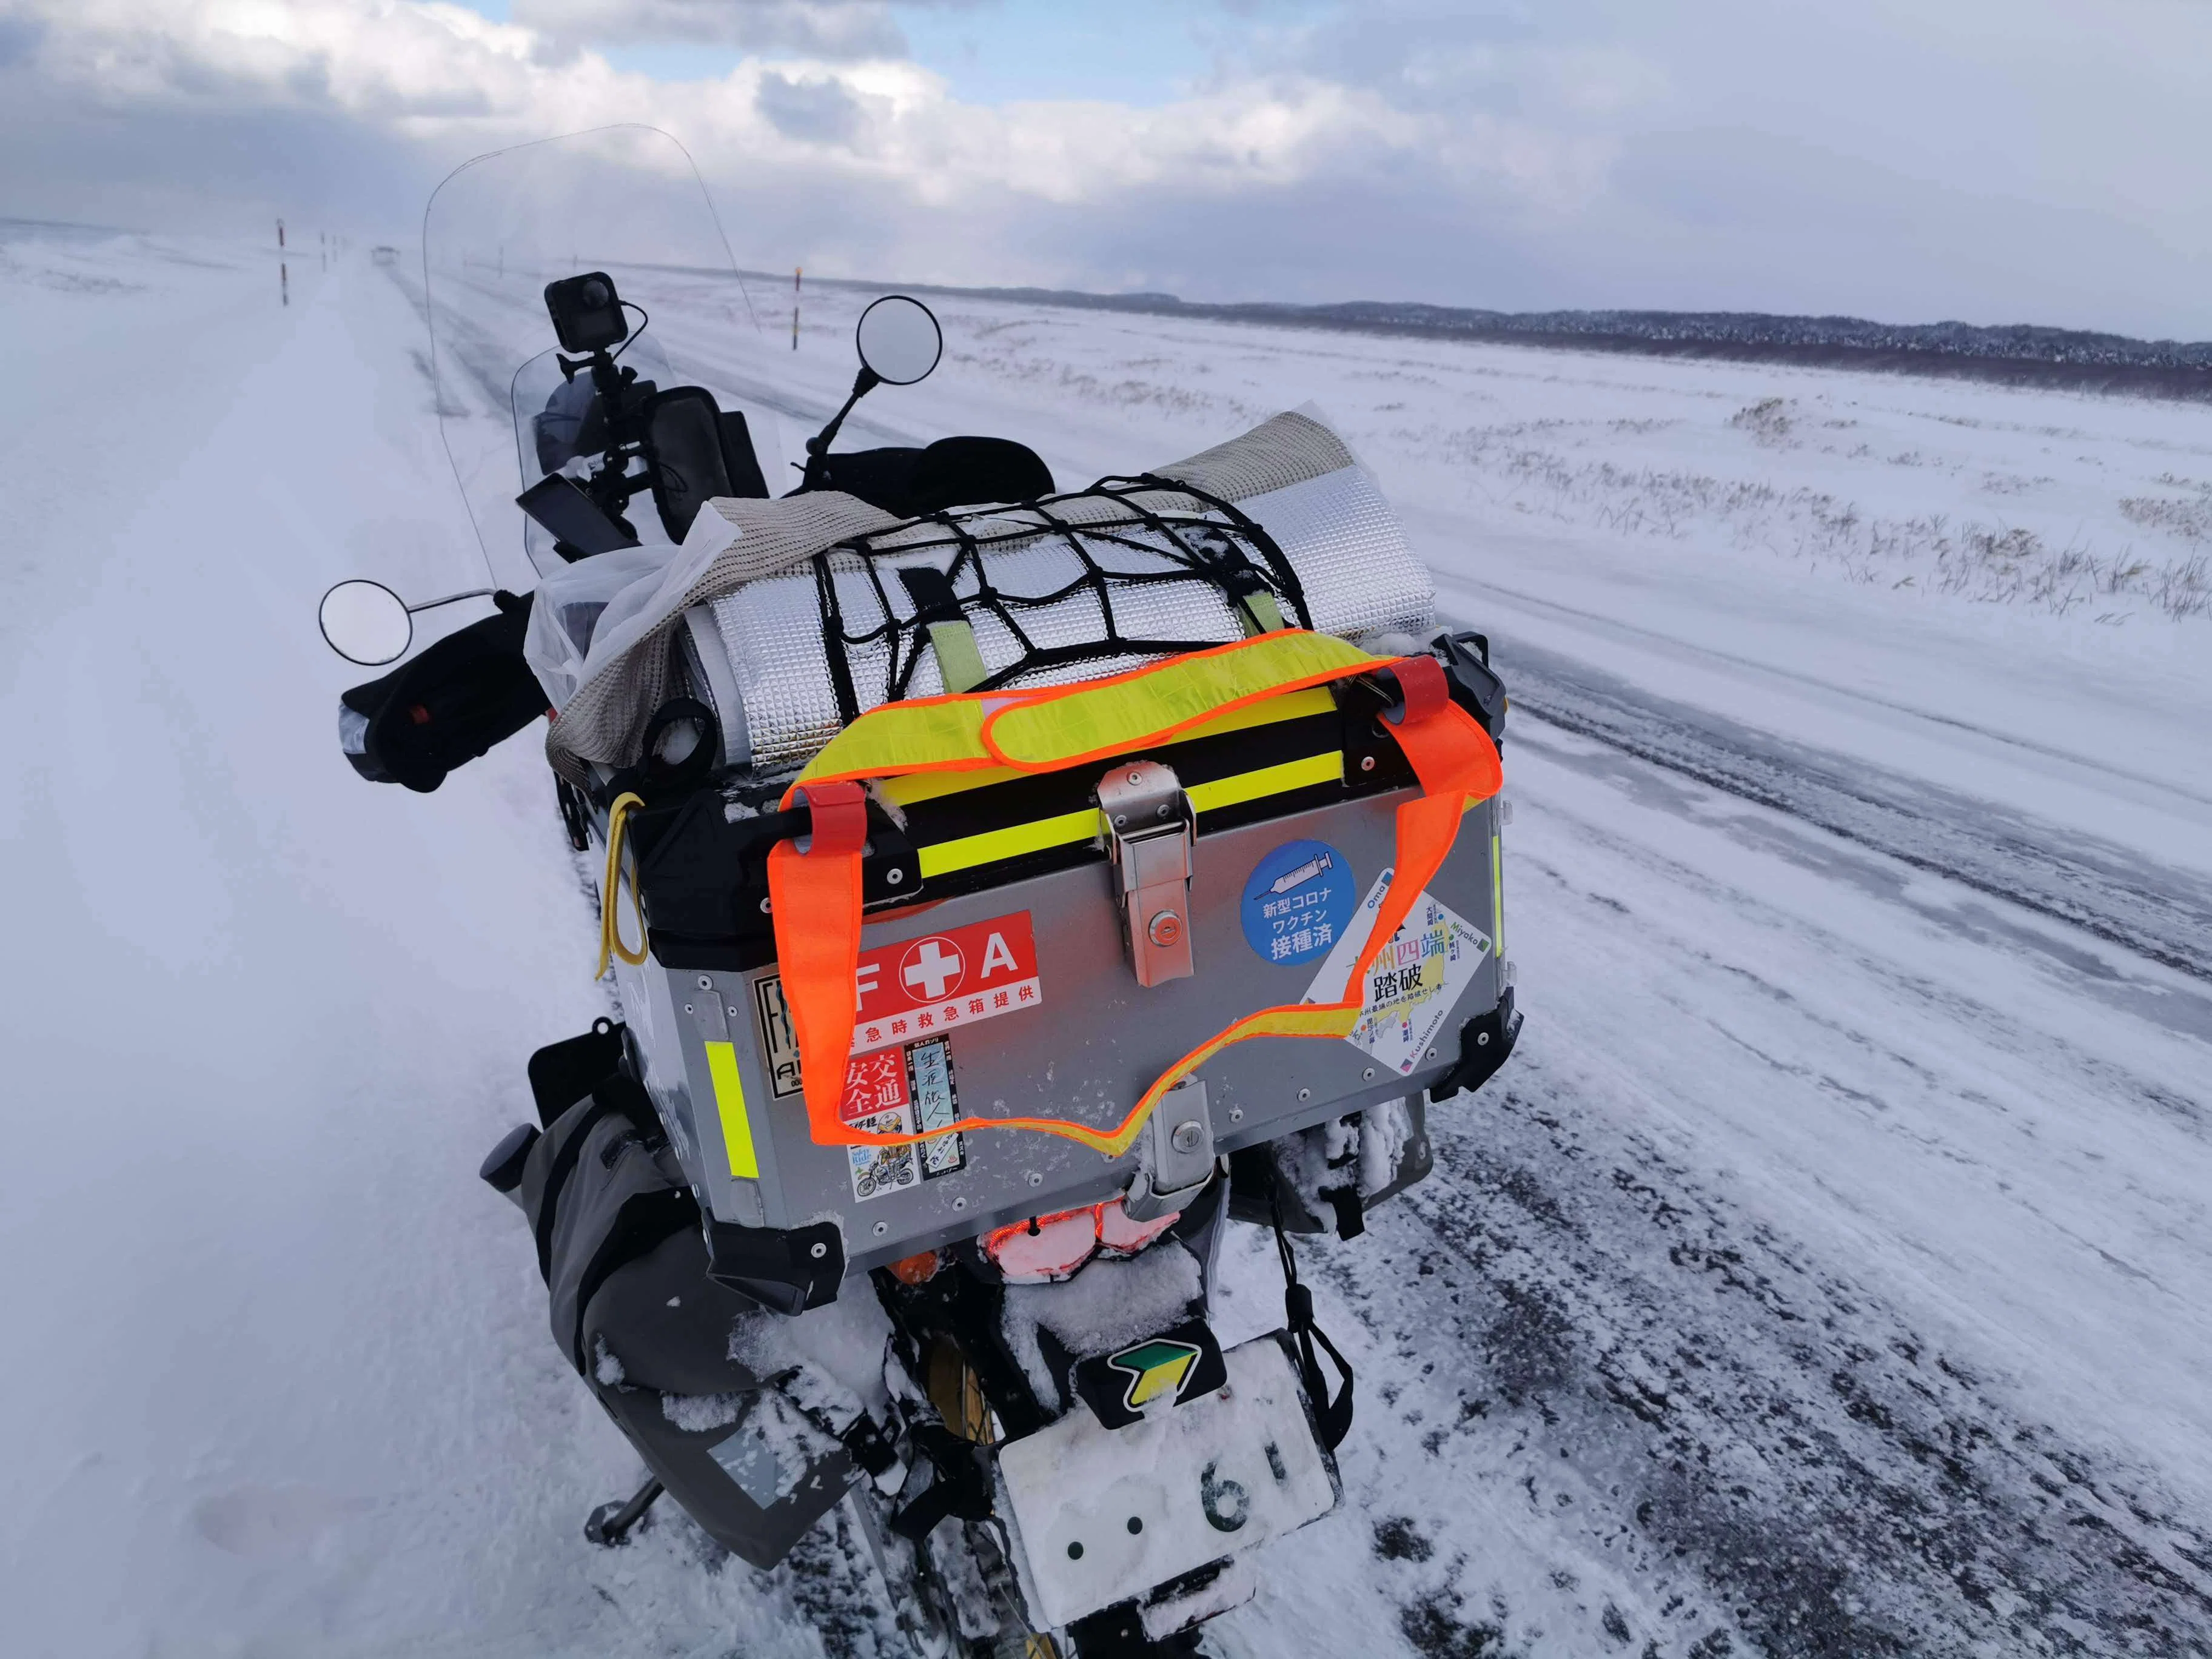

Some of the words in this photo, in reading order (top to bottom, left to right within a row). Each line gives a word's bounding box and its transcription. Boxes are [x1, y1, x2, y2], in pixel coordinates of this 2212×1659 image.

[1263, 888, 1332, 918] 新型コロナ
[1367, 886, 1386, 908] Oma
[1273, 910, 1327, 934] ワクチン
[1450, 922, 1478, 945] Miyako
[1271, 925, 1333, 960] 接種済
[856, 963, 880, 1011] F
[980, 931, 1018, 979] A
[1373, 964, 1423, 1002] 踏破
[850, 985, 1035, 1048] 急時救急箱提供
[1410, 1010, 1444, 1059] Kushimoto
[845, 1062, 873, 1116] 安全
[869, 1054, 901, 1108] 交通
